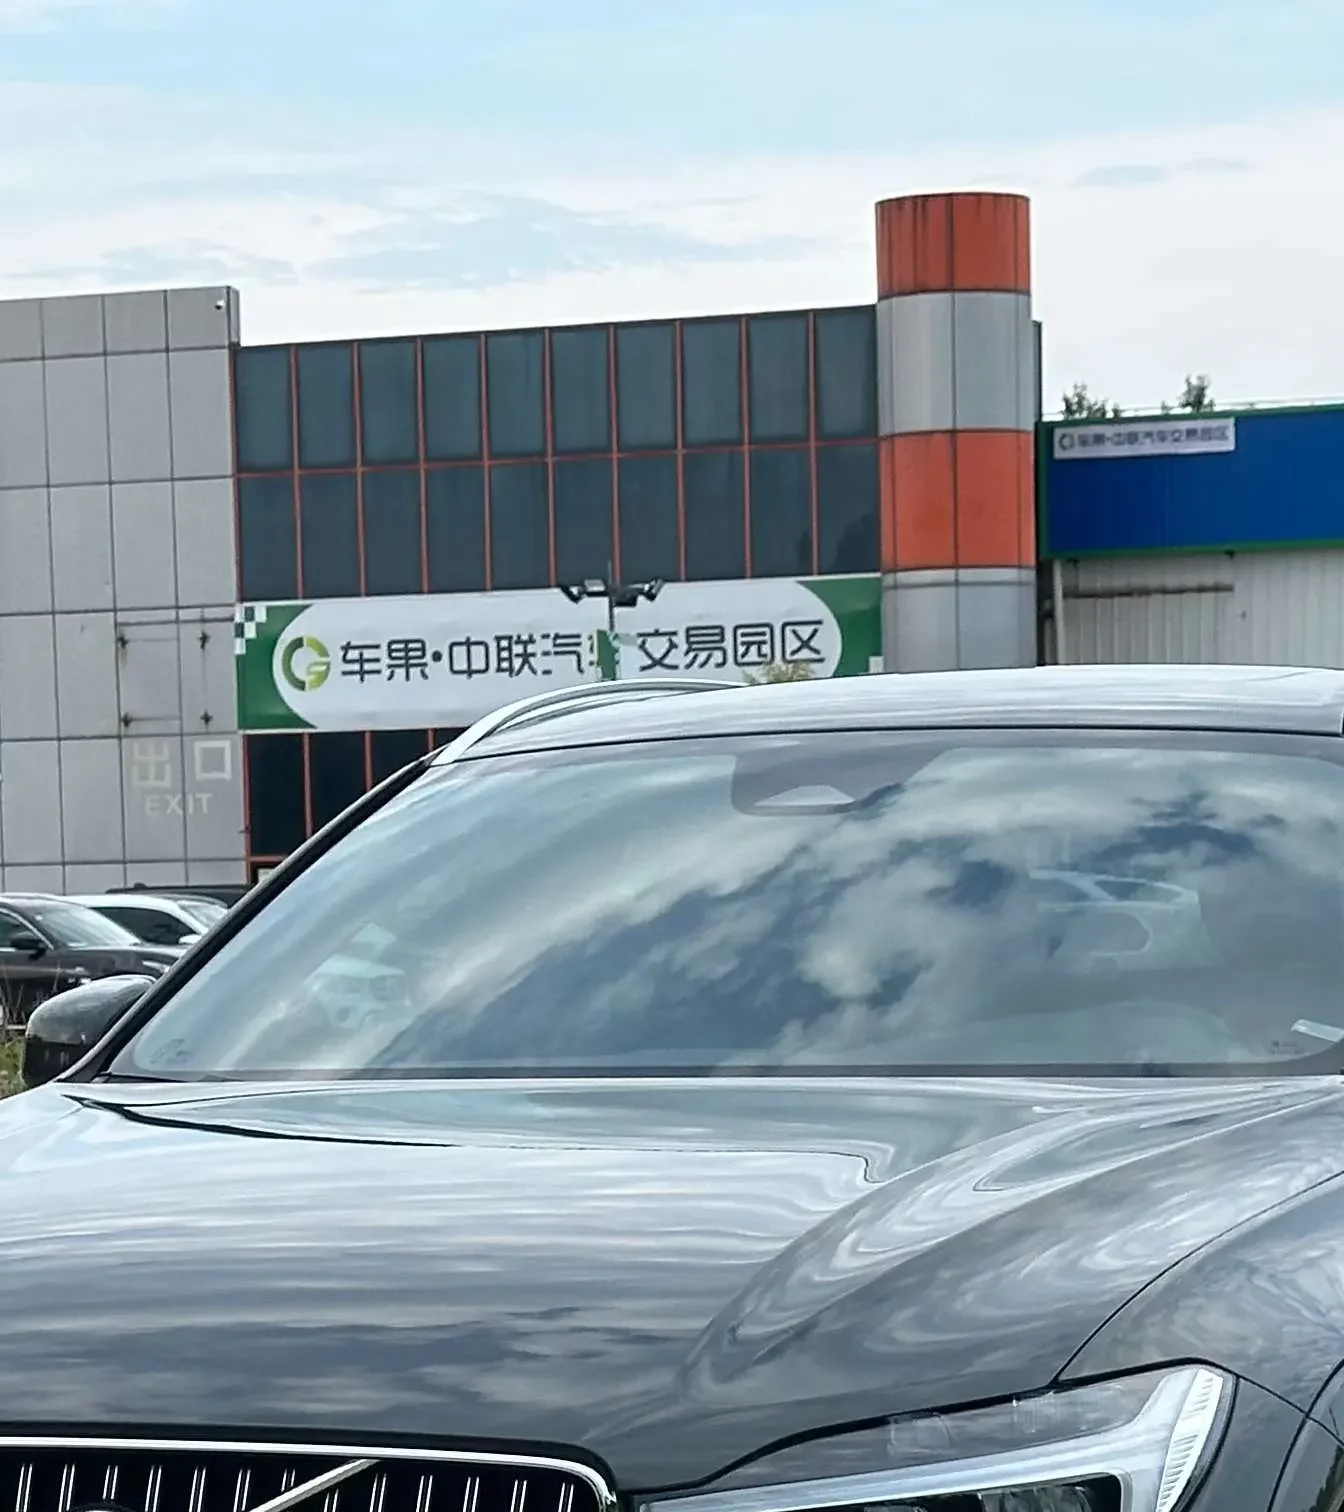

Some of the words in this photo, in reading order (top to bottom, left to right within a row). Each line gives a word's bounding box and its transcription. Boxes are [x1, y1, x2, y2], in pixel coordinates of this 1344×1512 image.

[339, 617, 828, 682] 车果·中联汽交易园区
[132, 740, 232, 789] 出口
[144, 792, 214, 816] EXIT
